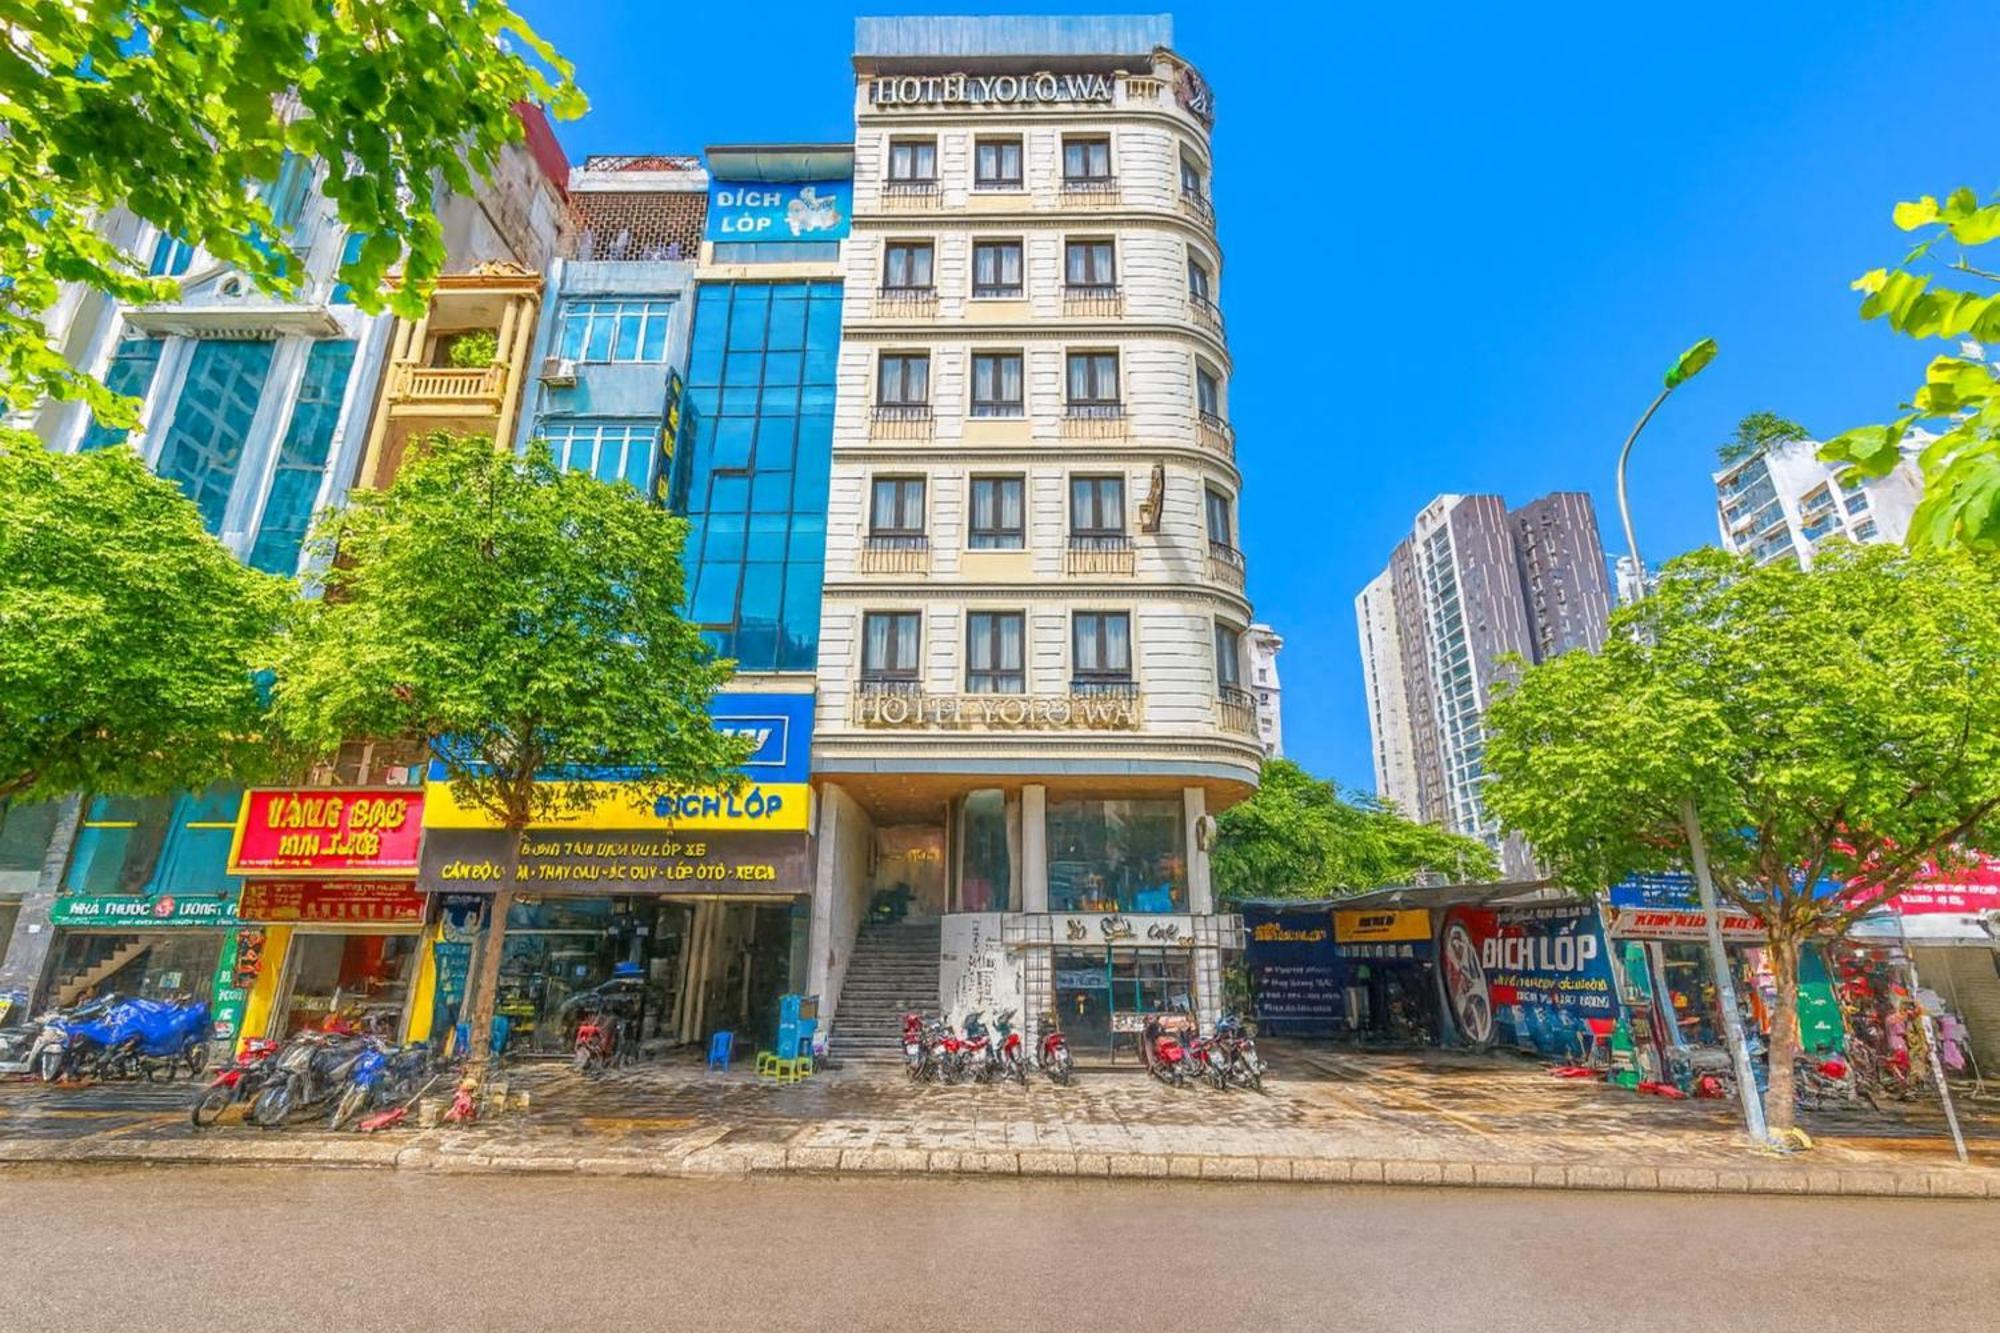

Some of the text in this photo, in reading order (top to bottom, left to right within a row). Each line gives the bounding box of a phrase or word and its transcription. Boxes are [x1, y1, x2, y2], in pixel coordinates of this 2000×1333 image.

[878, 75, 966, 104] HOTEL
[1065, 73, 1112, 100] WA
[1077, 699, 1137, 724] WA
